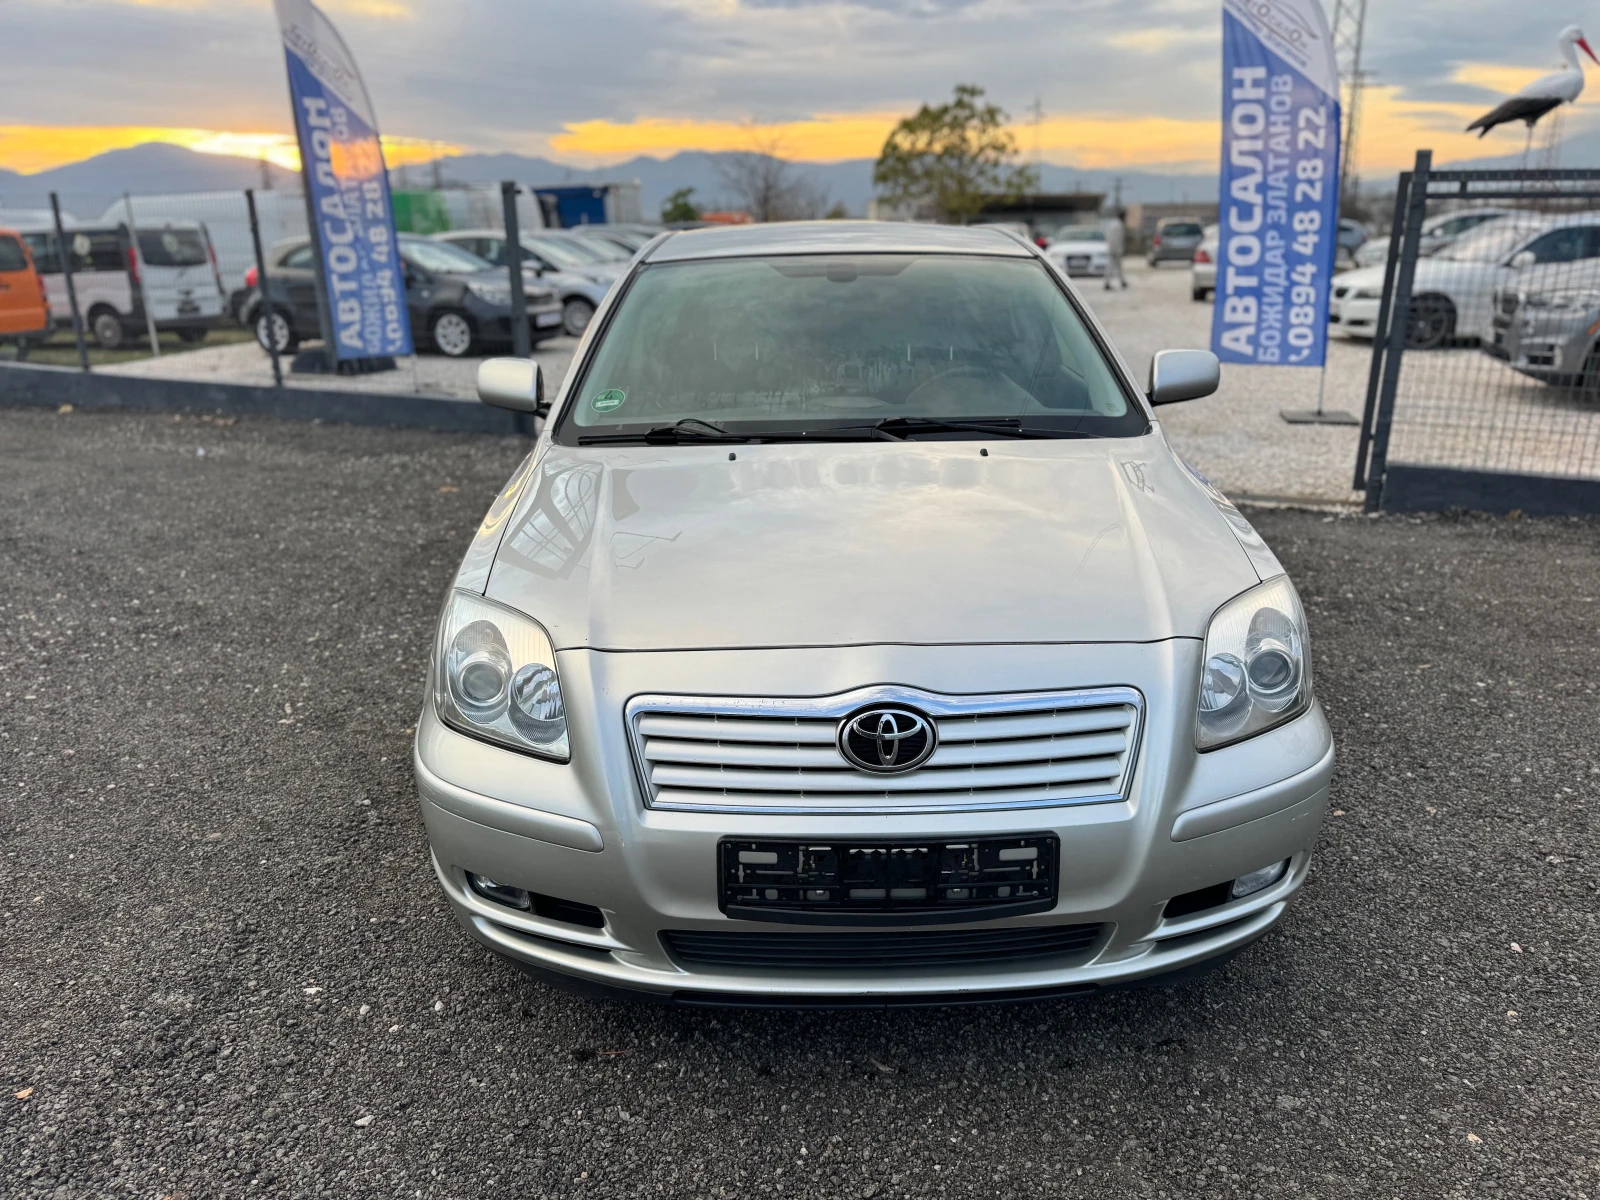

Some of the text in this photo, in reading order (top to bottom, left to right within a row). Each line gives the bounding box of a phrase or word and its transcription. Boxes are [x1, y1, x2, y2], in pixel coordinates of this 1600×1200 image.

[304, 96, 364, 349] АВТОСАЛОН
[1220, 66, 1267, 356] АВТОСАЛОН
[1266, 73, 1293, 225] ЗЛАТАНОВ
[1288, 106, 1327, 347] 0894 48 28 22
[1258, 232, 1288, 362] БОЖИДАР
